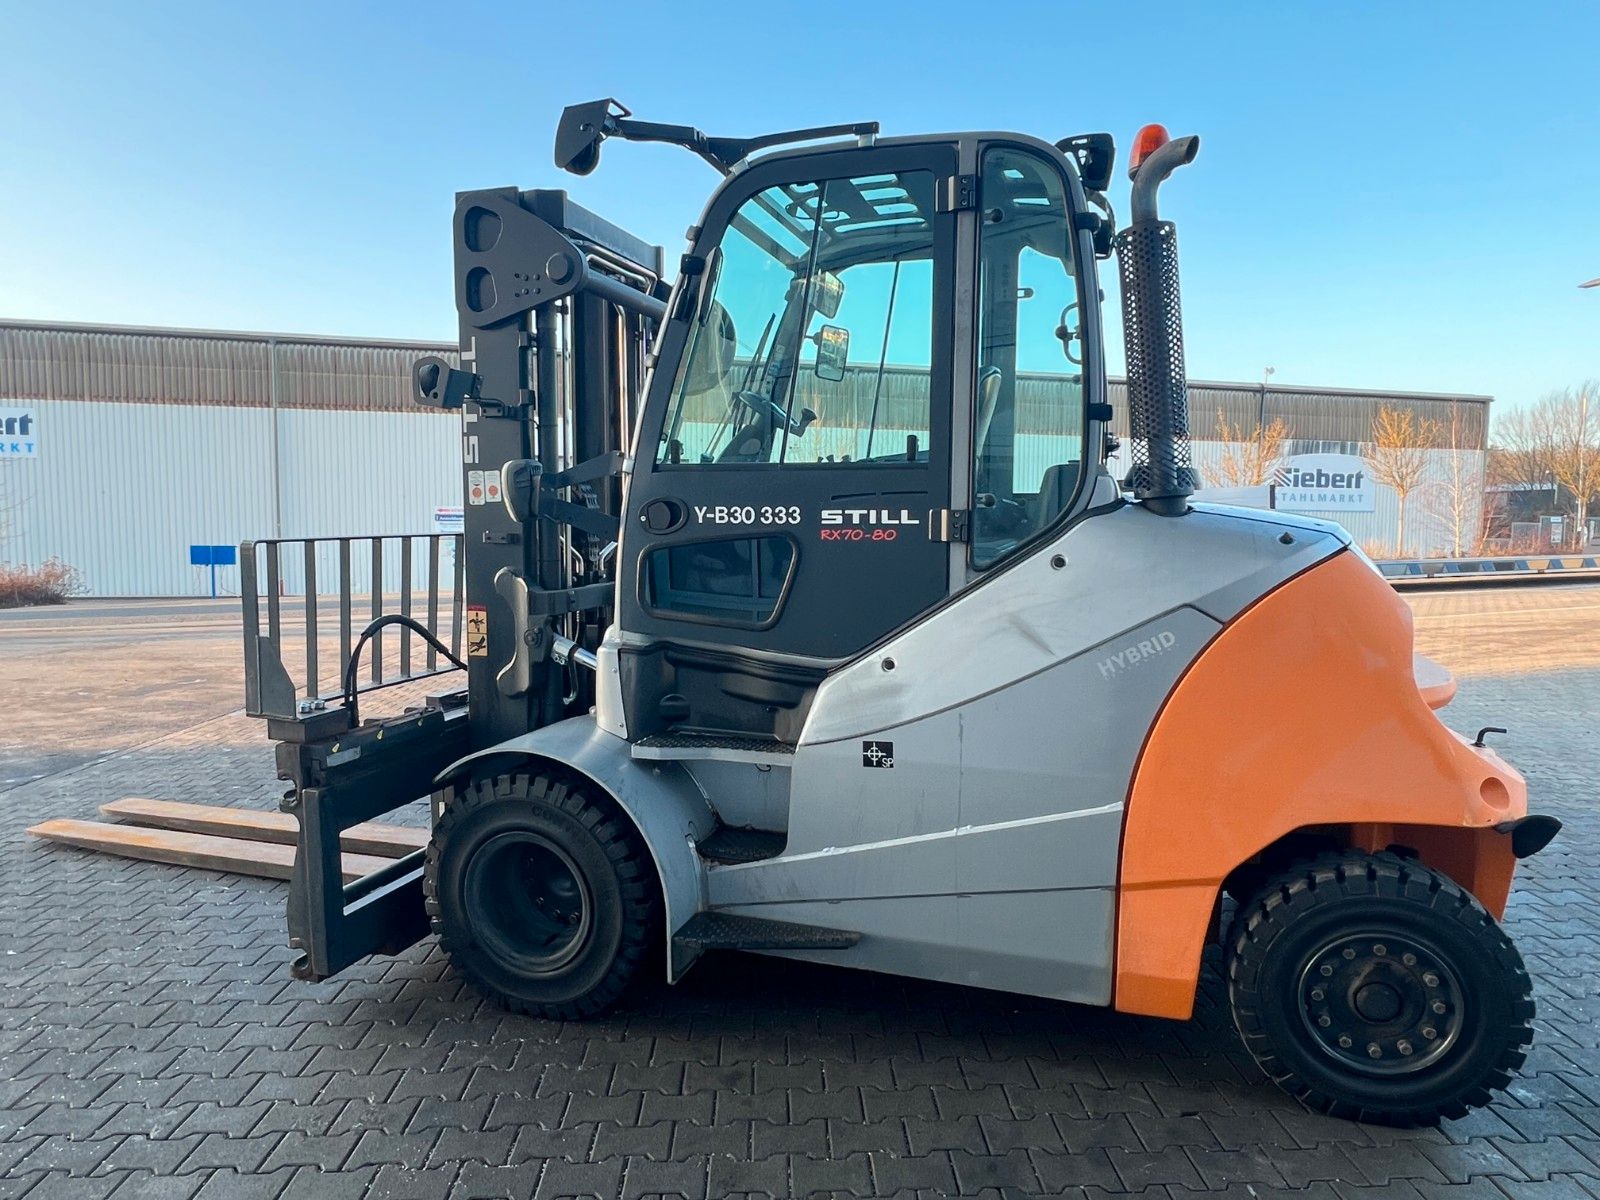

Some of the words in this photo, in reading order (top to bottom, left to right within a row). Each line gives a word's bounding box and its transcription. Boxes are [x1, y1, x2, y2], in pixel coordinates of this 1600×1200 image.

[0, 413, 33, 435] rt
[693, 505, 755, 525] Y-B30
[760, 505, 801, 525] 333
[820, 509, 920, 525] STILL
[820, 528, 897, 541] RX70-80
[1097, 631, 1176, 678] HYBRID
[881, 757, 894, 768] SP
